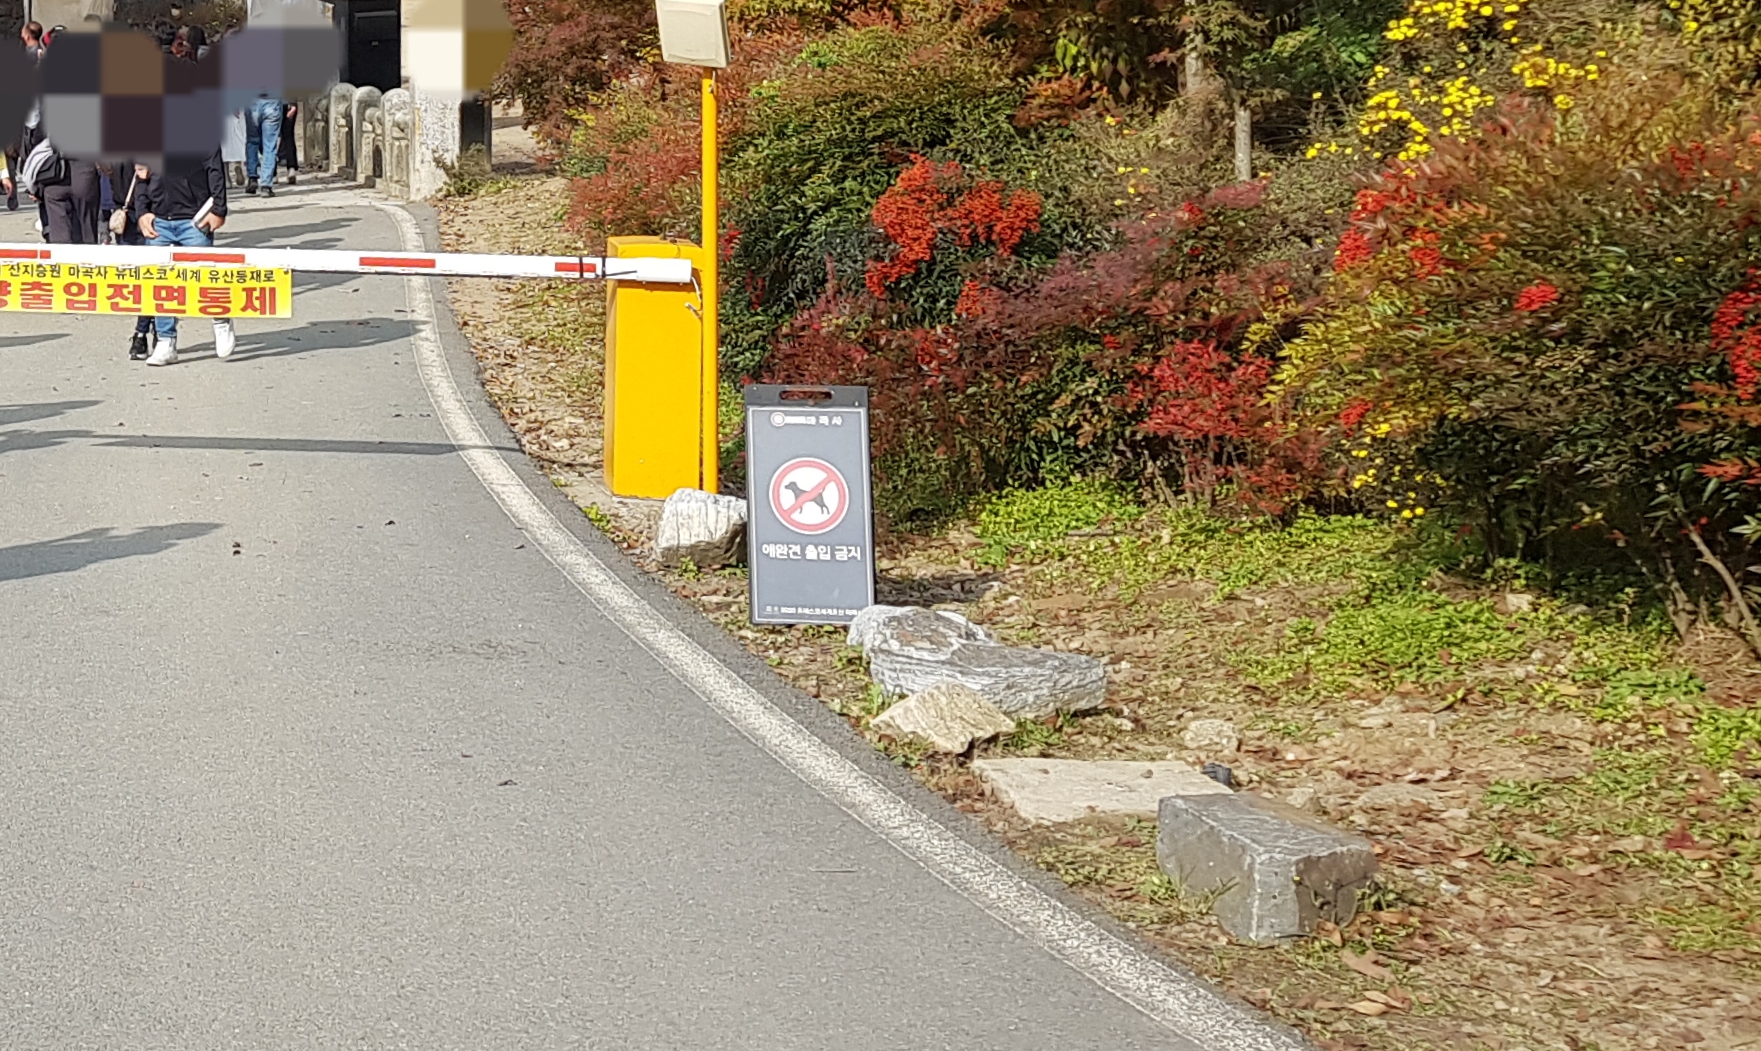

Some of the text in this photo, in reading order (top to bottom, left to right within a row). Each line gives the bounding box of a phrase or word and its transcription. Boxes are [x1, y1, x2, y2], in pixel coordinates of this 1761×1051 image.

[8, 262, 61, 278] 산지승원
[68, 265, 108, 279] 마곡사
[175, 270, 201, 283] 세계
[208, 270, 276, 284] 유산등재로
[761, 543, 861, 561] 애완견 출입 금지
